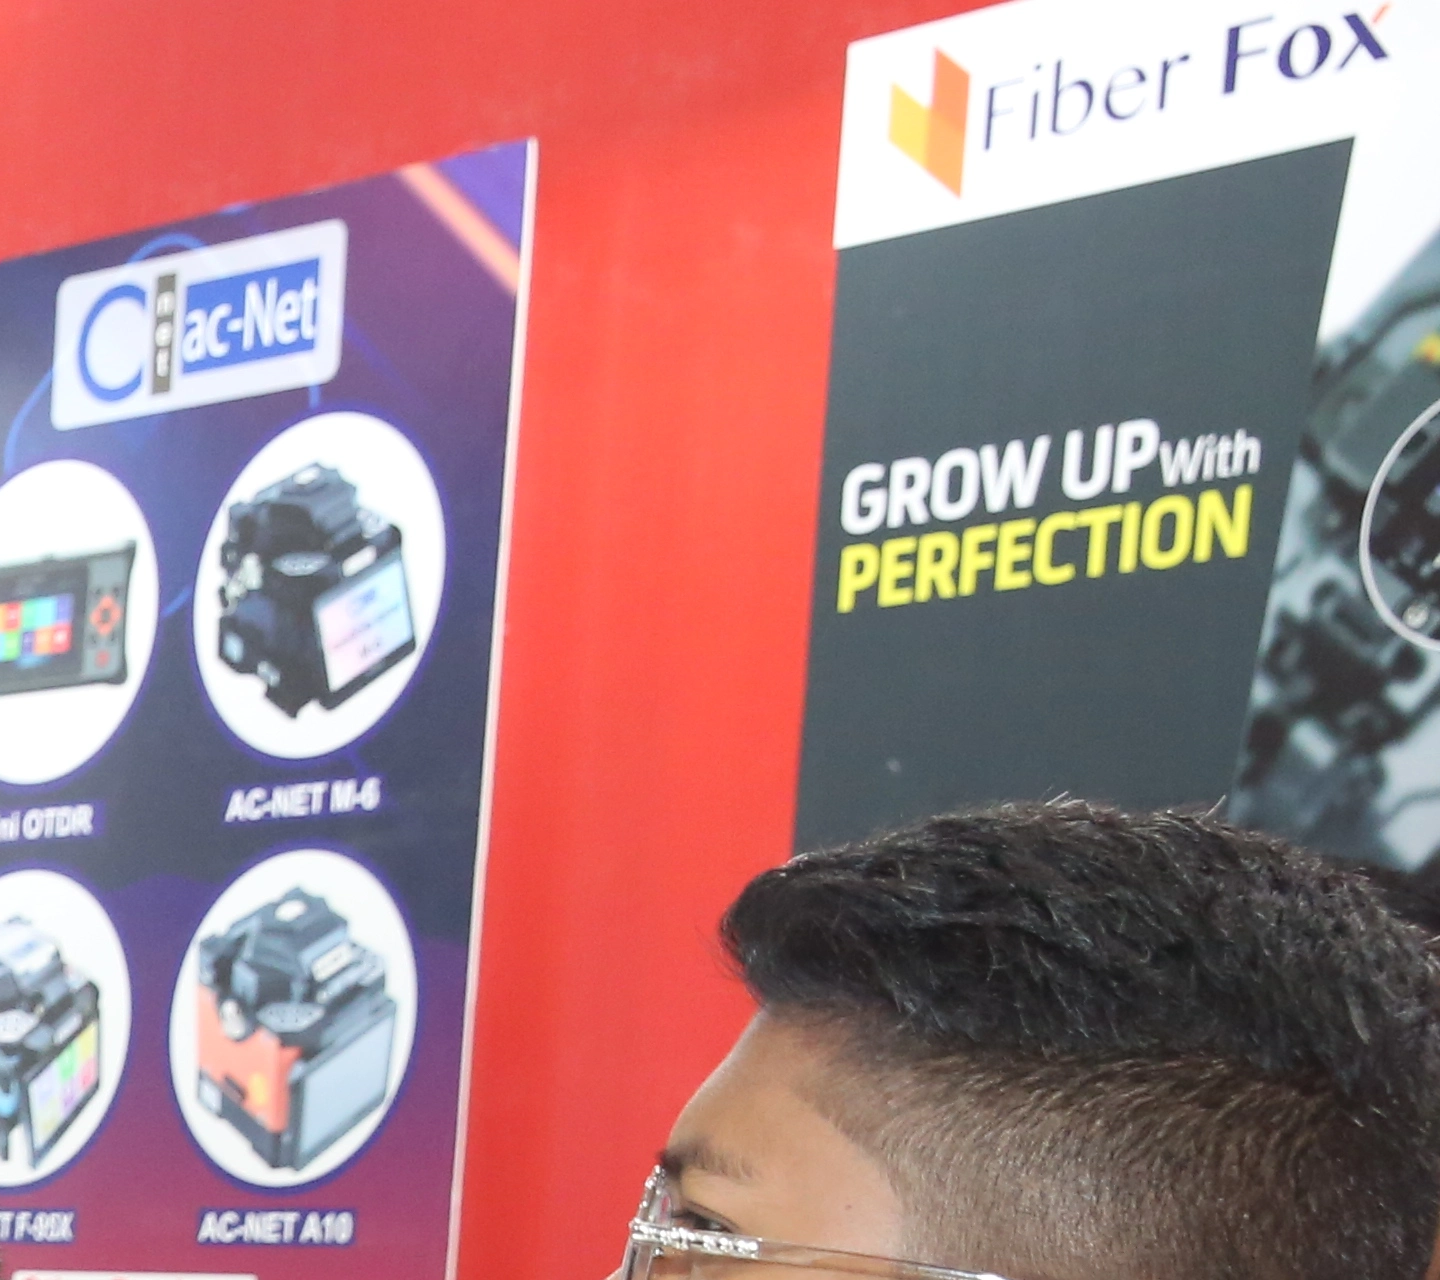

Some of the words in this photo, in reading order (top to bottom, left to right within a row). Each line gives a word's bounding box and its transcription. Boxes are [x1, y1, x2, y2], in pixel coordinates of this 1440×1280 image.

[983, 50, 1192, 152] Fiber
[1221, 10, 1391, 98] Fox
[841, 434, 1051, 537] GROW
[1062, 417, 1160, 499] UP
[1159, 428, 1261, 488] With
[837, 484, 1252, 614] PERFECTION
[22, 803, 94, 840] OTDR
[224, 781, 329, 823] AC-NET
[197, 1211, 302, 1244] AC-NET
